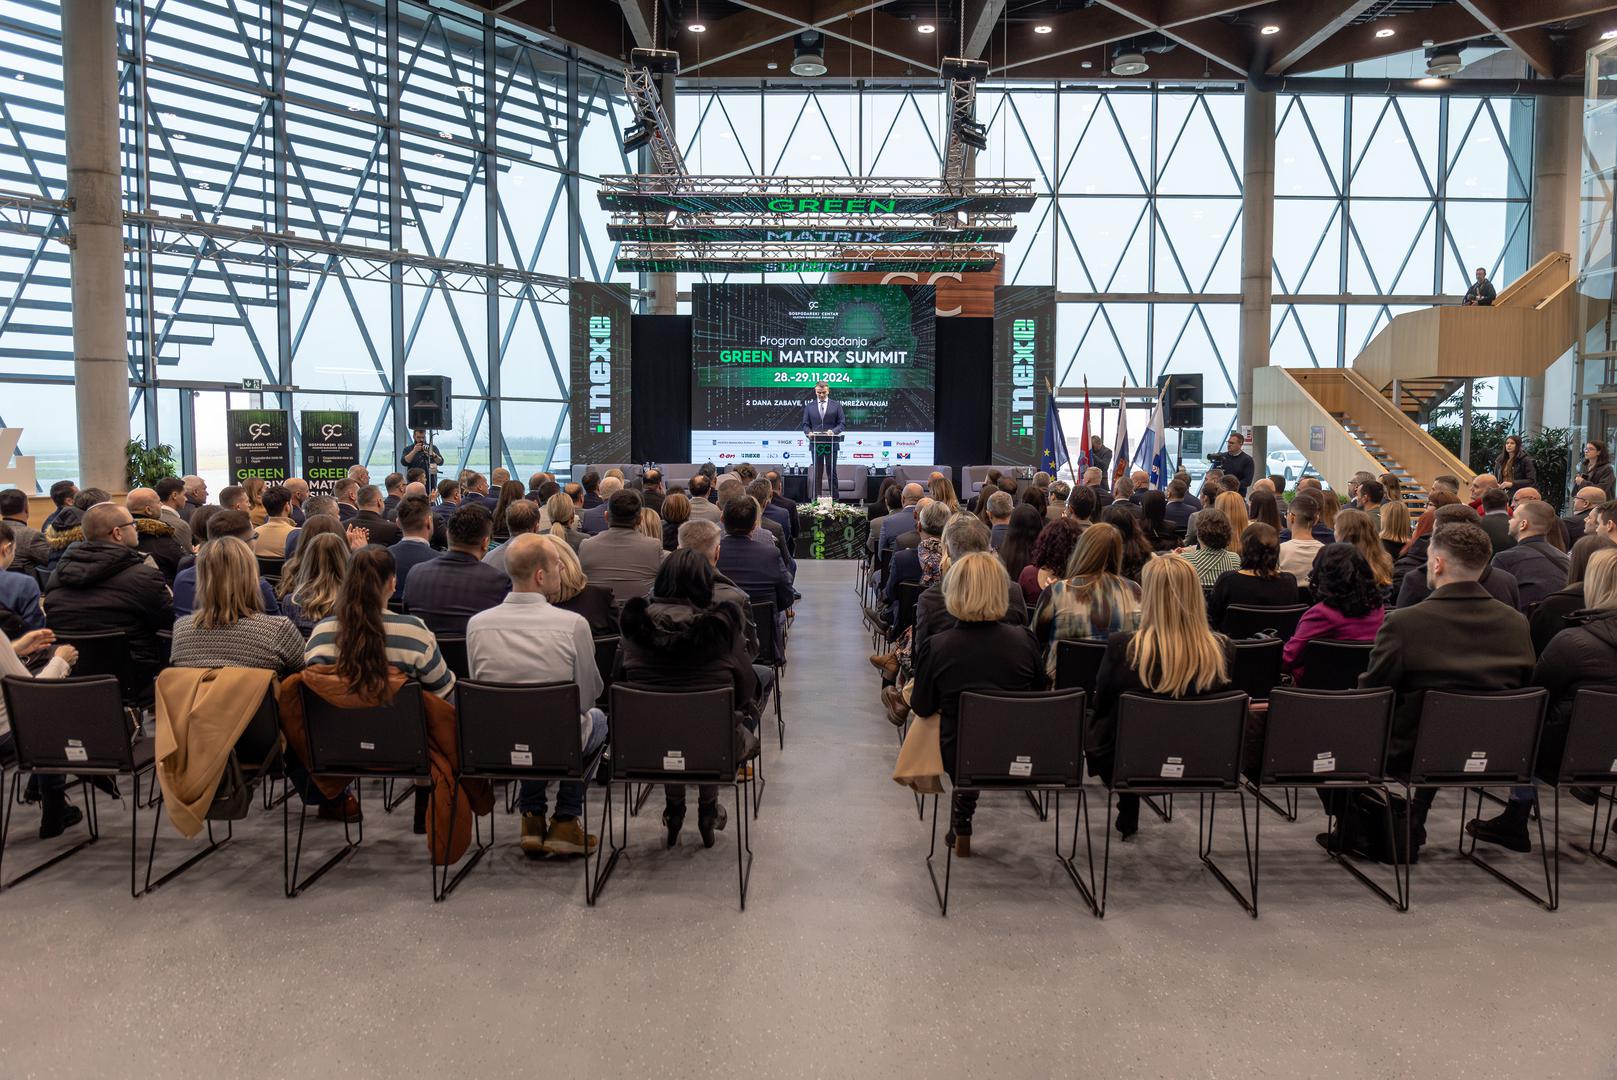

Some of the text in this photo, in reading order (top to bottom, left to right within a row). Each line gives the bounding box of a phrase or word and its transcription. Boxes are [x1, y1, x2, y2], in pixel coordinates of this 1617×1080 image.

[768, 199, 897, 213] GREEN
[766, 231, 884, 242] MATRIX
[760, 336, 868, 348] Program događanja
[589, 316, 611, 410] nexe
[720, 350, 908, 364] GREEN MATRIX SUMMIT
[1012, 319, 1035, 413] nexe
[774, 399, 803, 408] ZABAVE,
[237, 468, 284, 480] GREEN
